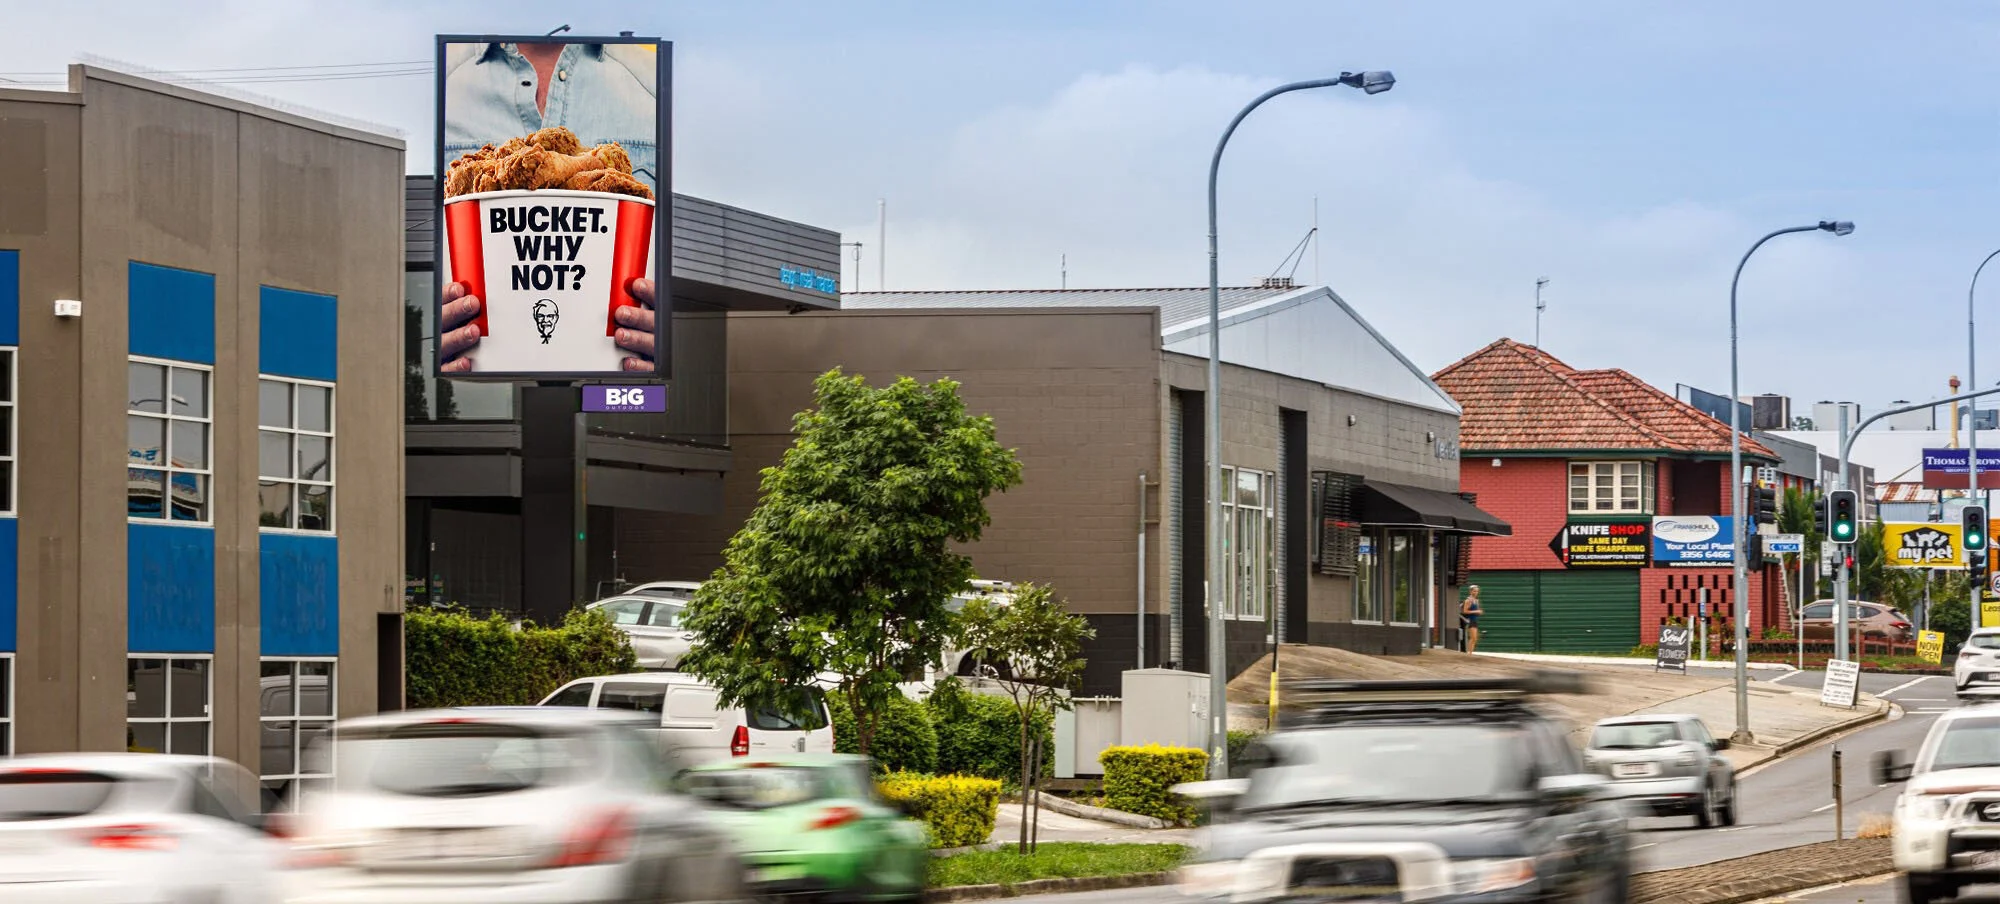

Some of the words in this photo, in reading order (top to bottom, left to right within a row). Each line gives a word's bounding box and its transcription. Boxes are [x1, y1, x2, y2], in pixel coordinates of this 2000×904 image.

[490, 205, 608, 233] BUCKET.
[513, 235, 585, 261] WHY
[511, 264, 586, 291] NOT?
[1925, 456, 1966, 466] THOMAS
[1588, 537, 1610, 545] SAME
[1611, 537, 1628, 545] DAY
[1570, 545, 1594, 553] KNIFE
[1596, 545, 1646, 553] SHARPENING
[1898, 547, 1922, 563] my
[1924, 544, 1953, 563] pet
[1680, 551, 1703, 559] 3356
[1659, 629, 1688, 645] Soul
[1919, 641, 1941, 652] NOW
[1658, 648, 1686, 659] FLOWERS
